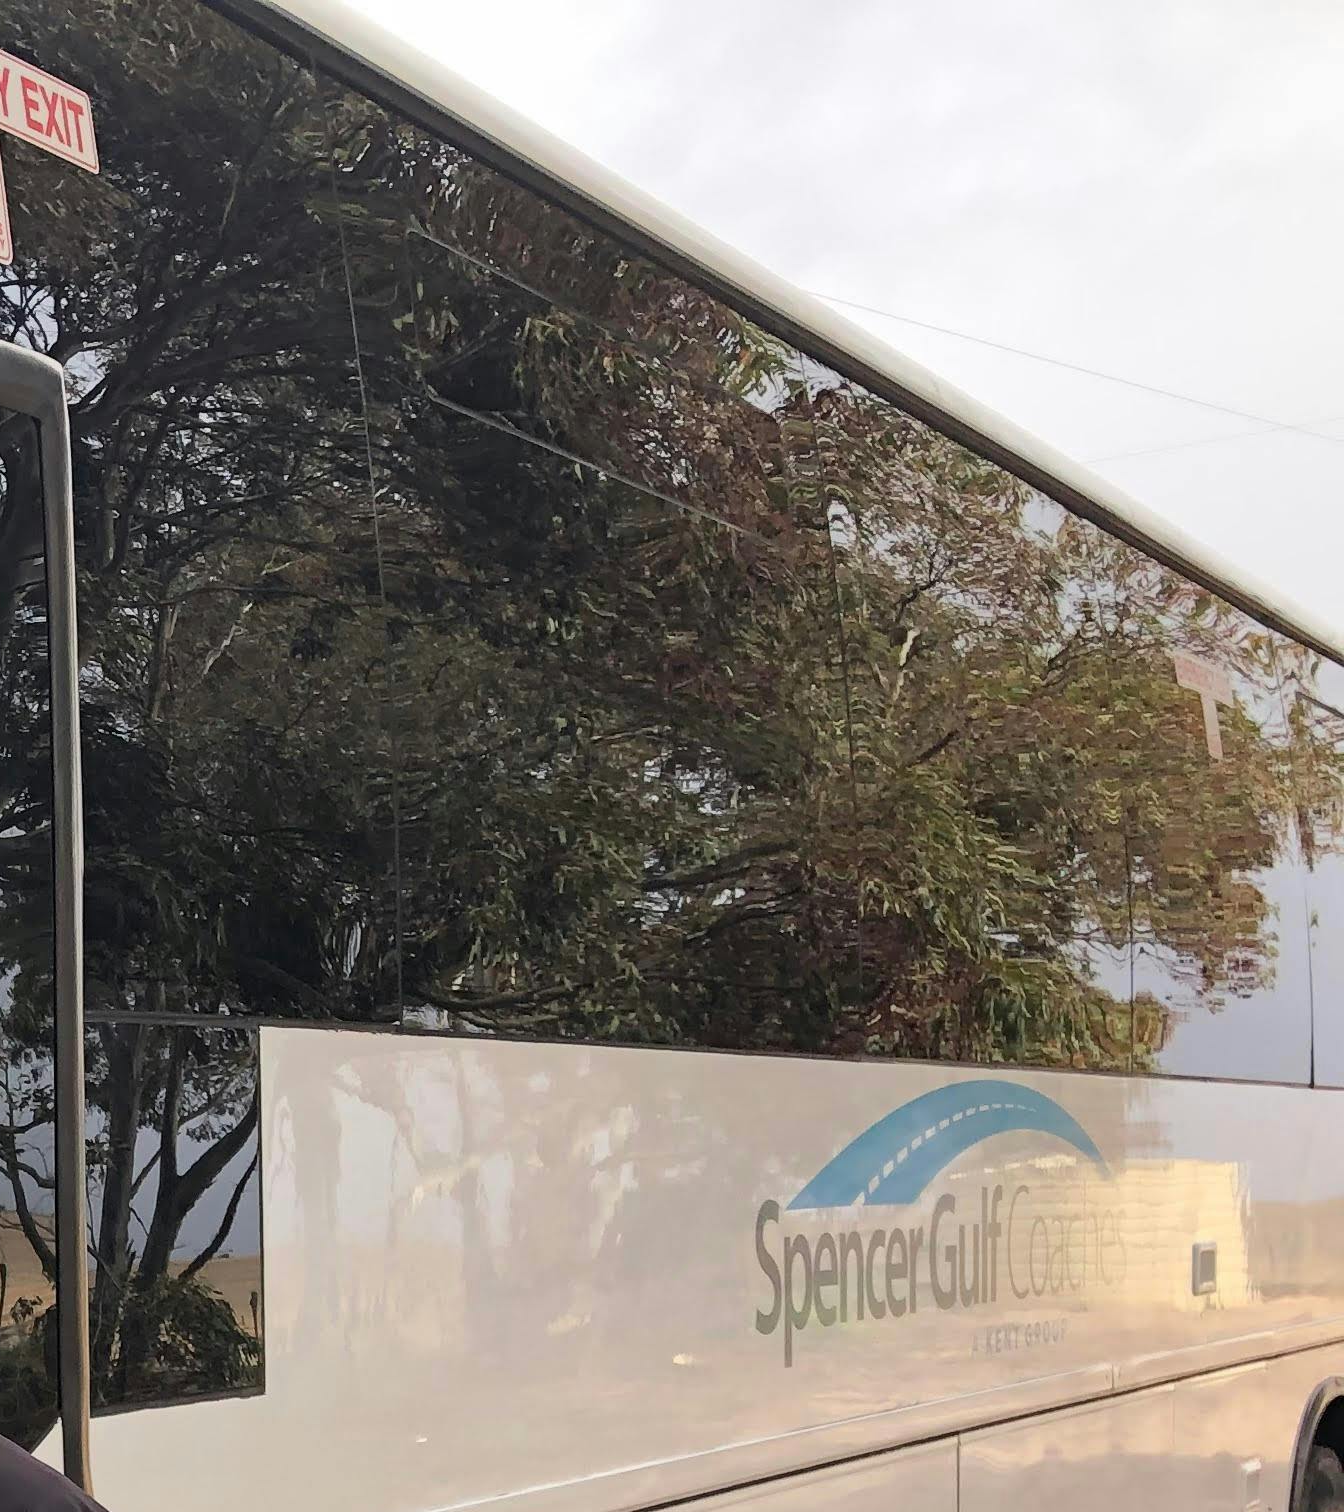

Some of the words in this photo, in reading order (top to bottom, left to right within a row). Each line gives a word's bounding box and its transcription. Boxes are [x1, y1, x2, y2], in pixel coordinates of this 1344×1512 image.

[20, 75, 85, 154] EXIT
[754, 1199, 924, 1368] Spencer
[928, 1184, 1004, 1311] Gulf
[985, 1324, 1021, 1354] KENT
